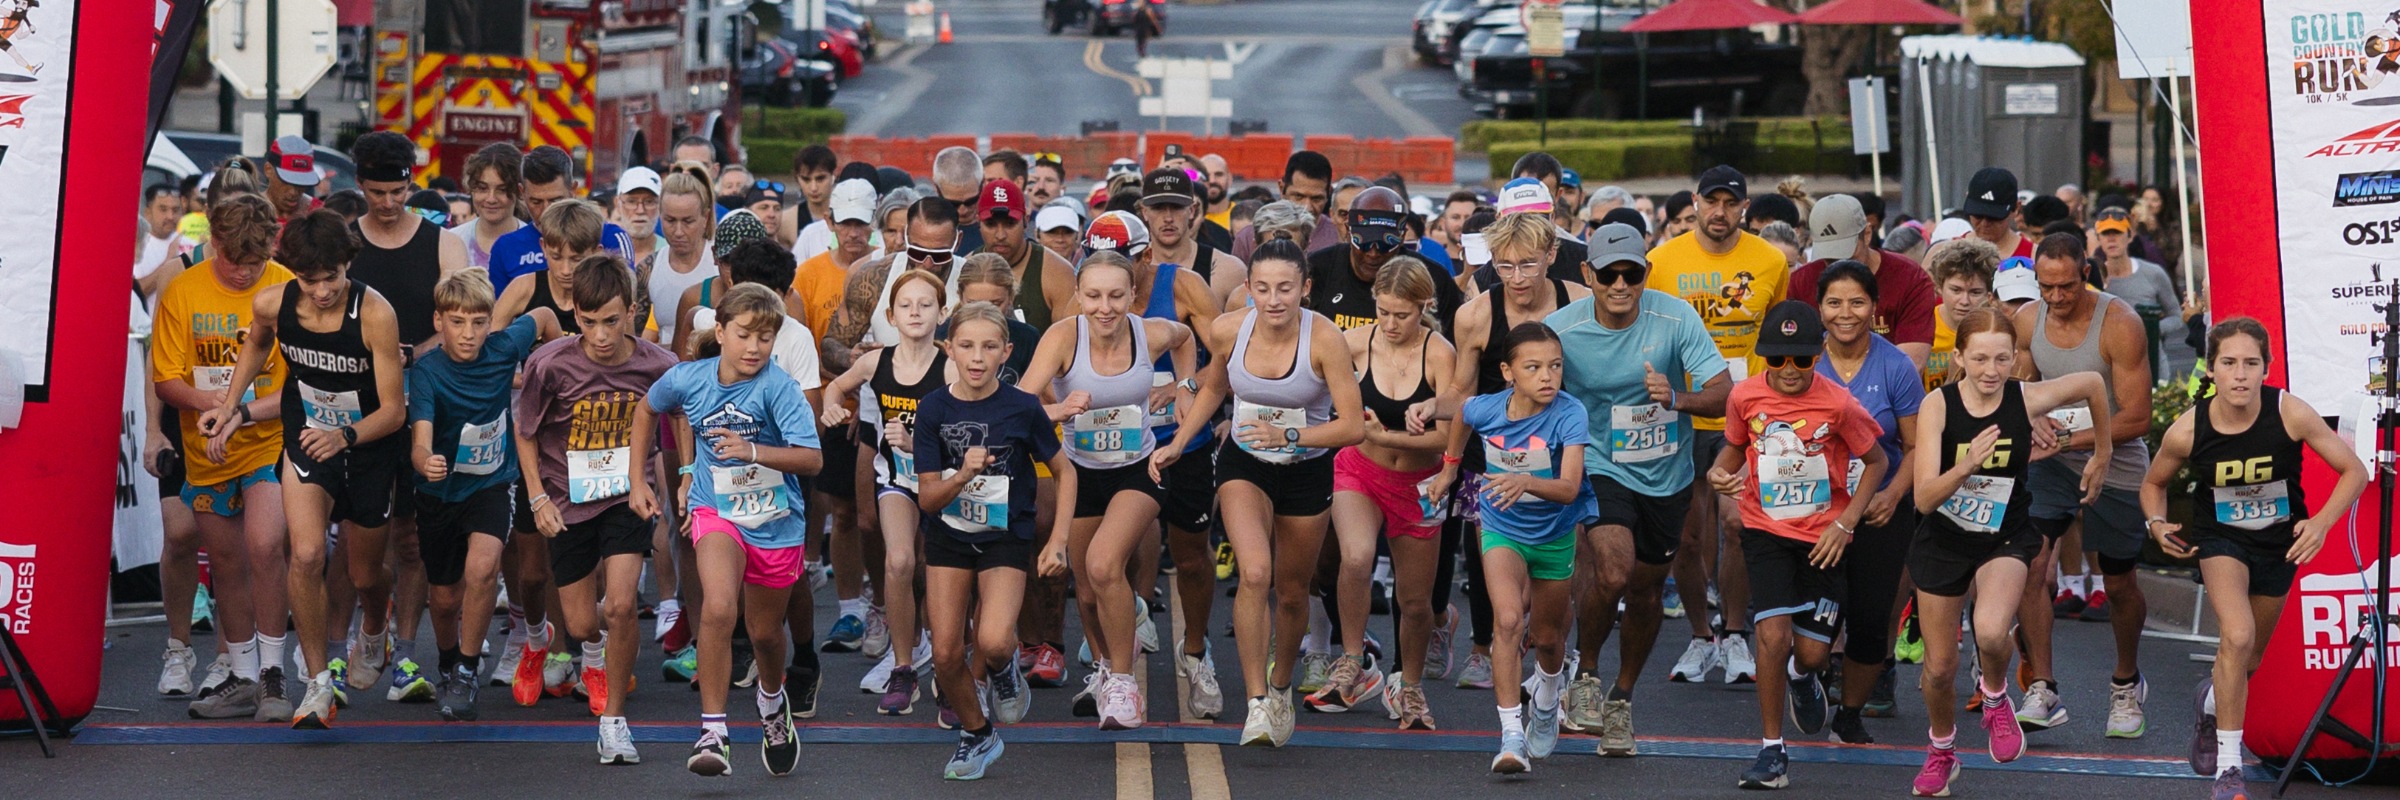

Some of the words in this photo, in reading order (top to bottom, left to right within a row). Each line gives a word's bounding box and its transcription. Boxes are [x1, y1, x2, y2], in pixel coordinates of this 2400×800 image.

[2291, 11, 2365, 43] GOLD
[2293, 40, 2365, 60] COUNTRY
[2294, 57, 2368, 94] RUN
[2306, 95, 2322, 103] 10K
[2336, 93, 2348, 101] 5K
[451, 116, 518, 133] ENGINE
[2304, 140, 2400, 158] ALTR
[1678, 272, 1722, 291] GOLD
[2332, 285, 2391, 298] SUPERI
[1689, 298, 1723, 318] UN
[193, 313, 239, 332] GOLD
[2340, 324, 2367, 335] GOLD
[280, 342, 370, 374] PONDEROSA
[881, 393, 921, 411] BUFFA
[312, 405, 352, 426] 293
[1093, 430, 1123, 451] 88
[1625, 425, 1667, 450] 256
[468, 437, 503, 464] 349
[2215, 455, 2273, 487] PG
[582, 476, 626, 502] 283
[1772, 481, 1818, 507] 257
[729, 489, 778, 517] 282
[959, 500, 987, 524] 89
[1948, 497, 1995, 524] 326
[2229, 499, 2278, 520] 335
[13, 561, 35, 635] RACES
